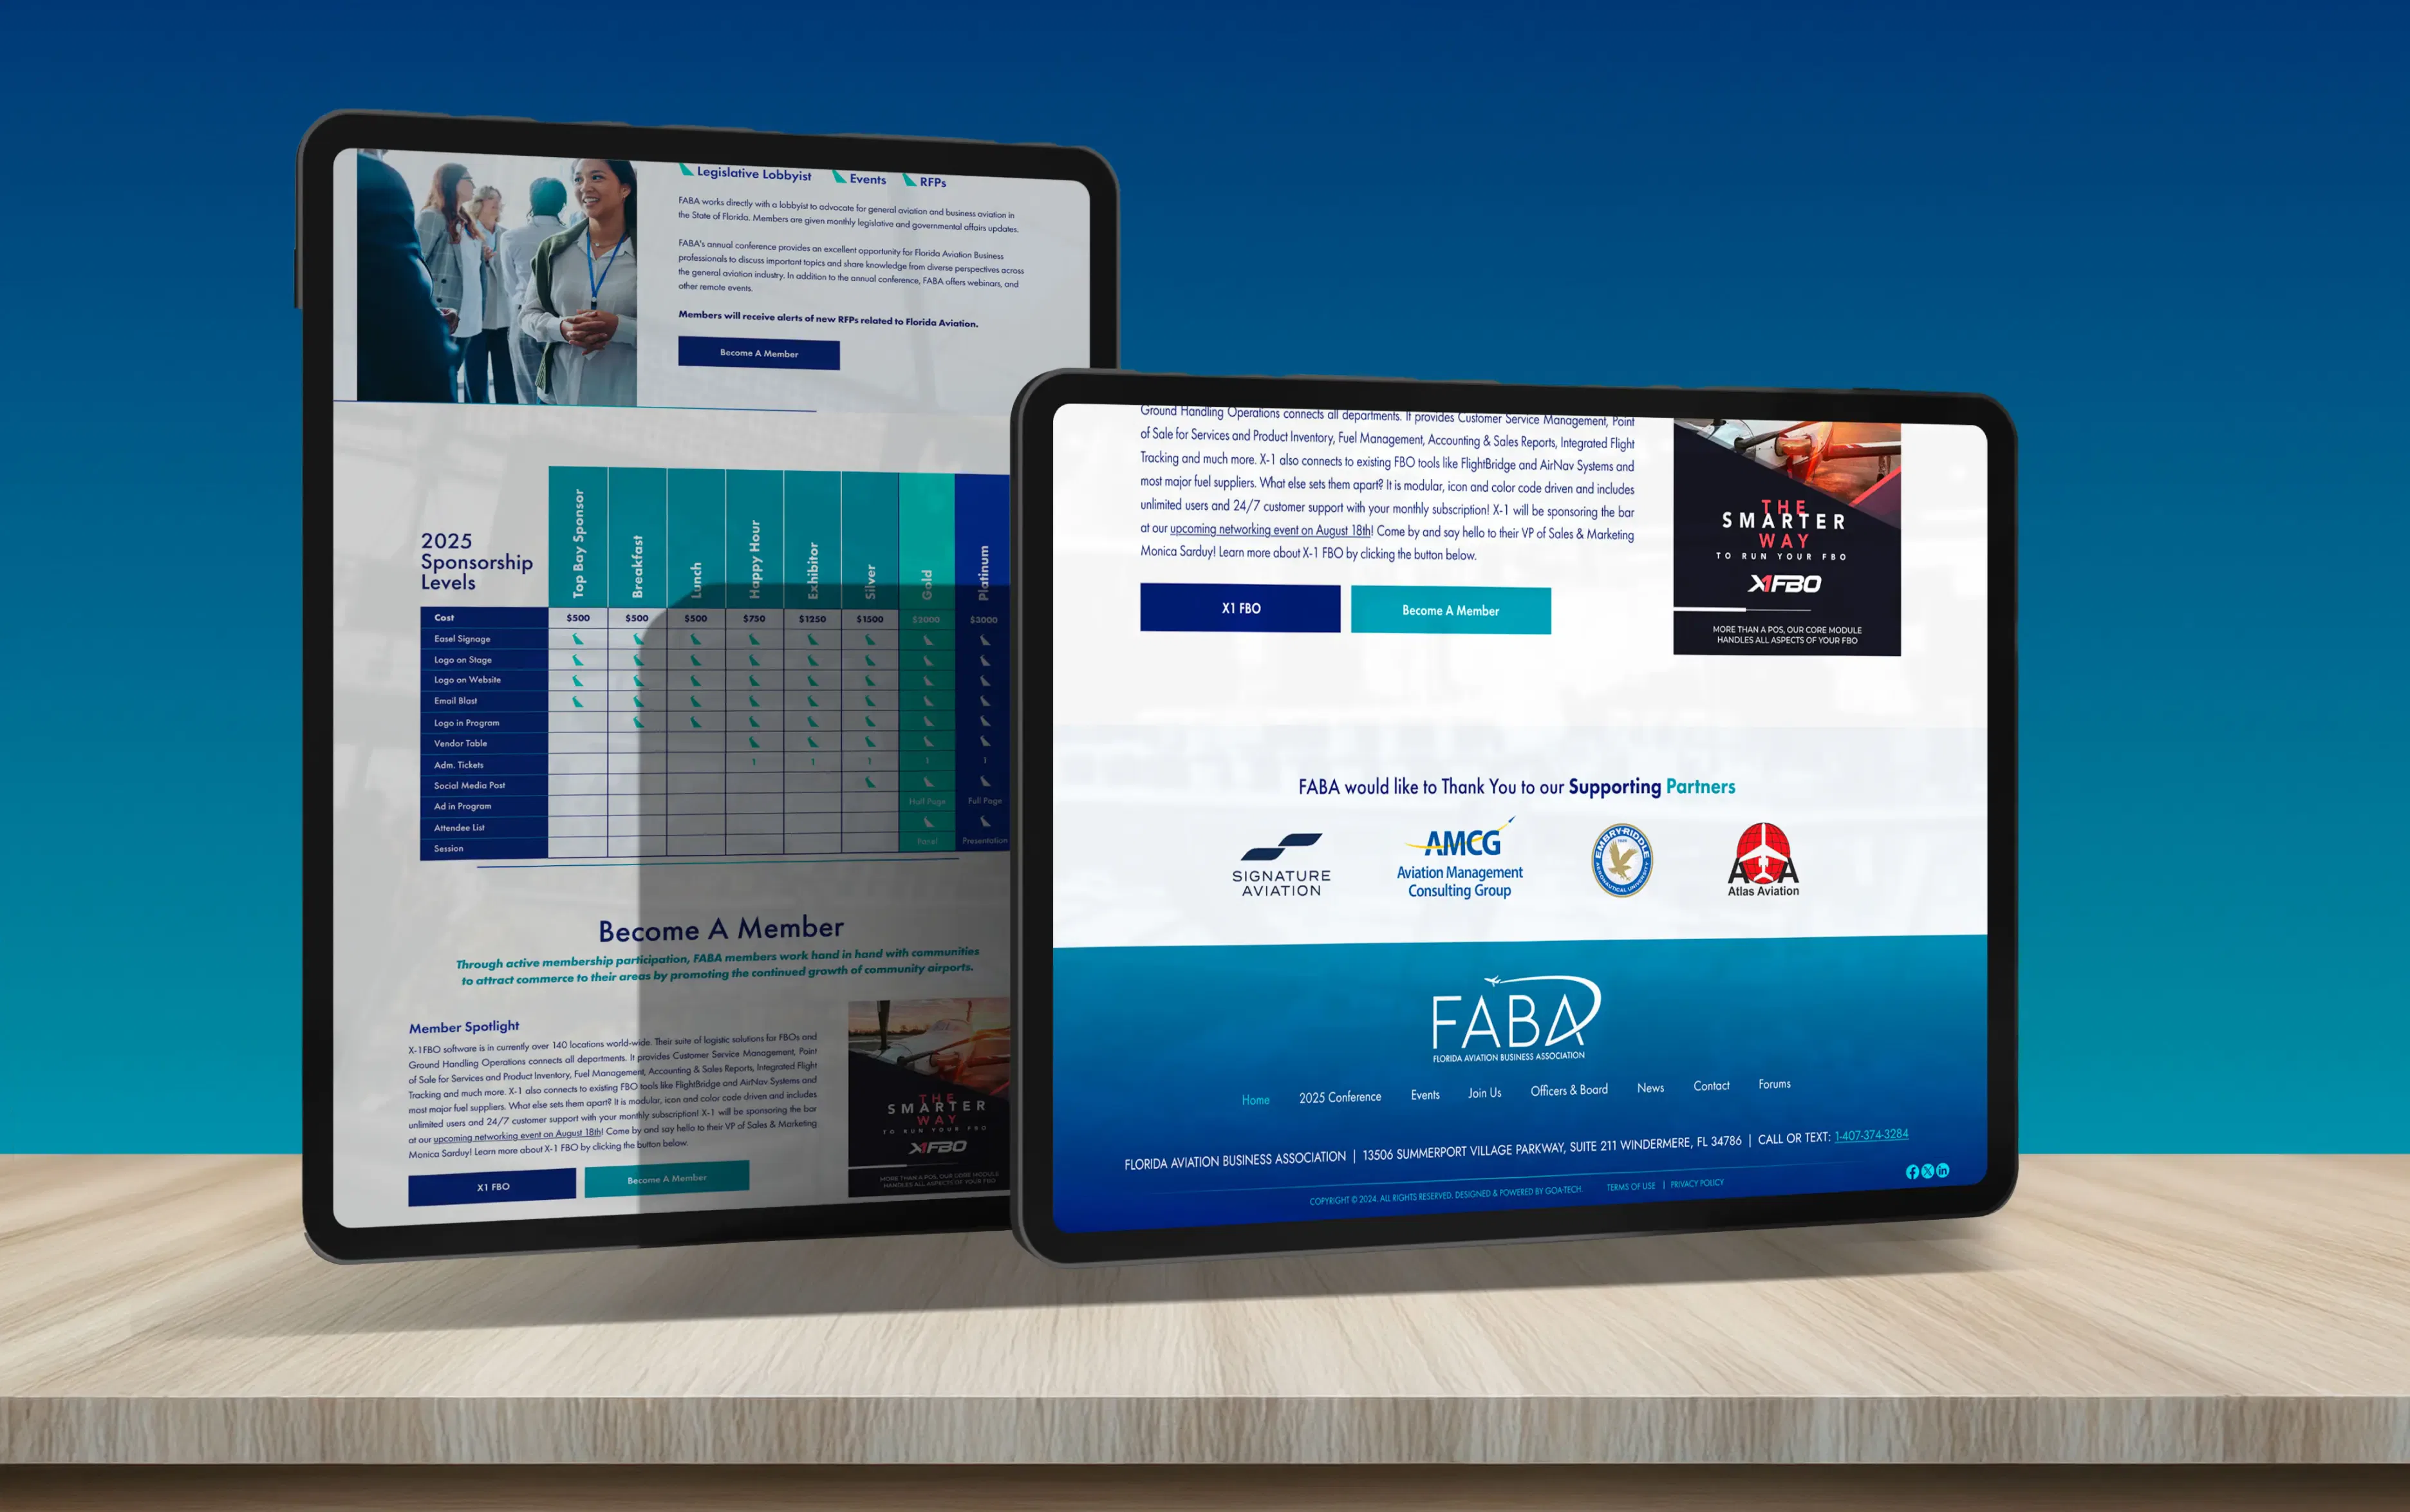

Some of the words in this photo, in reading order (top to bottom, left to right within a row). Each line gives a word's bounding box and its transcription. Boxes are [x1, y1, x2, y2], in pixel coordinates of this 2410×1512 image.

[698, 166, 759, 179] Legislative
[763, 169, 811, 183] Lobbyist
[850, 173, 886, 184] Events
[920, 177, 946, 188] RFPs
[679, 196, 700, 205] FABA
[702, 198, 724, 206] works
[726, 198, 752, 209] directly
[780, 200, 808, 210] lobbyist
[819, 202, 854, 212] advocate
[856, 203, 866, 212] for
[868, 206, 896, 214] general
[899, 207, 927, 215] aviation
[946, 208, 976, 218] business
[763, 350, 799, 358] Member
[1761, 499, 1806, 514] THE
[573, 489, 587, 543] Sponsor
[1722, 512, 1845, 530] SMARTER
[422, 532, 472, 548] 2025
[749, 519, 760, 552] Hour
[1759, 533, 1809, 548] WAY
[422, 553, 533, 574] Sponsorship
[573, 546, 587, 571] Bay
[631, 535, 643, 598] Breakfast
[807, 542, 818, 600] Exhibitor
[749, 555, 763, 599] Happy
[977, 545, 989, 601] Platinum
[422, 573, 476, 590] Levels
[690, 562, 702, 599] Lunch
[864, 564, 876, 600] Silver
[921, 570, 933, 600] Gold
[573, 575, 587, 599] Top
[1222, 602, 1235, 614] X1
[1240, 602, 1261, 614] FBO
[1403, 604, 1443, 616] Become
[1445, 605, 1453, 615] A
[1456, 604, 1500, 616] Member
[566, 614, 590, 622] $500
[625, 614, 649, 622] $500
[684, 614, 708, 622] $500
[743, 614, 766, 623] $750
[799, 615, 827, 624] $1250
[856, 615, 884, 624] $1500
[912, 615, 940, 624] $2000
[970, 615, 998, 624] $3000
[458, 635, 490, 644] Signage
[434, 656, 454, 666] Logo
[469, 655, 492, 666] Stage
[434, 676, 454, 686] Logo
[458, 696, 477, 705] Blast
[434, 719, 454, 728] Logo
[466, 719, 500, 728] Program
[434, 761, 456, 769] Adm.
[434, 781, 458, 790] Social
[461, 781, 487, 789] Media
[1300, 779, 1340, 794] FABA
[1344, 777, 1388, 795] would
[1394, 777, 1418, 794] like
[1423, 780, 1437, 794] to
[1441, 777, 1484, 794] Thank
[1489, 778, 1516, 794] You
[1521, 781, 1535, 794] to
[1540, 784, 1564, 794] our
[1569, 777, 1661, 799] Supporting
[1667, 778, 1735, 794] Partners
[434, 844, 463, 852] Session
[1425, 828, 1501, 857] AMCG
[1233, 870, 1330, 882] SIGNATURE
[1397, 866, 1443, 879] Aviation
[1446, 866, 1523, 882] Management
[1242, 884, 1320, 896] AVIATION
[1408, 883, 1471, 900] Consulting
[1475, 884, 1511, 899] Group
[1728, 886, 1754, 896] Atlas
[1757, 886, 1799, 896] Aviation
[600, 920, 700, 942] Become
[707, 917, 729, 940] A
[738, 914, 845, 939] Member
[409, 1022, 462, 1034] Member
[465, 1020, 519, 1034] Spotlight
[1432, 993, 1585, 1049] FABA
[1433, 1054, 1462, 1063] FLORIDA
[1500, 1052, 1533, 1061] BUSINESS
[1536, 1051, 1585, 1060] ASSOCIATION
[1531, 1085, 1567, 1096] Officers
[1569, 1085, 1577, 1096] &
[1580, 1082, 1608, 1094] Board
[1638, 1083, 1665, 1093] News
[1694, 1080, 1730, 1091] Contact
[1759, 1079, 1791, 1089] Forums
[1299, 1092, 1325, 1103] 2025
[1328, 1090, 1381, 1103] Conference
[1411, 1089, 1440, 1100] Events
[1468, 1087, 1486, 1098] Join
[1490, 1087, 1501, 1097] Us
[1242, 1095, 1270, 1105] Home
[1125, 1158, 1168, 1170] FLORIDA
[1171, 1155, 1219, 1168] AVIATION
[1223, 1153, 1272, 1166] BUSINESS
[1275, 1150, 1346, 1164] ASSOCIATION
[1363, 1149, 1393, 1161] 13506
[1397, 1146, 1466, 1159] SUMMERPORT
[1470, 1144, 1512, 1156] VILLAGE
[1517, 1142, 1565, 1155] PARKWAY,
[1571, 1141, 1596, 1152] SUITE
[1601, 1140, 1616, 1151] 211
[1620, 1137, 1693, 1150] WINDERMERE,
[1697, 1137, 1708, 1147] FL
[1712, 1135, 1742, 1146] 34786
[1759, 1134, 1784, 1145] CALL
[1786, 1133, 1802, 1143] OR
[1805, 1132, 1831, 1143] TEXT:
[1835, 1128, 1909, 1142] 1-407-374-3284
[628, 1177, 660, 1185] Become
[672, 1173, 706, 1182] Member
